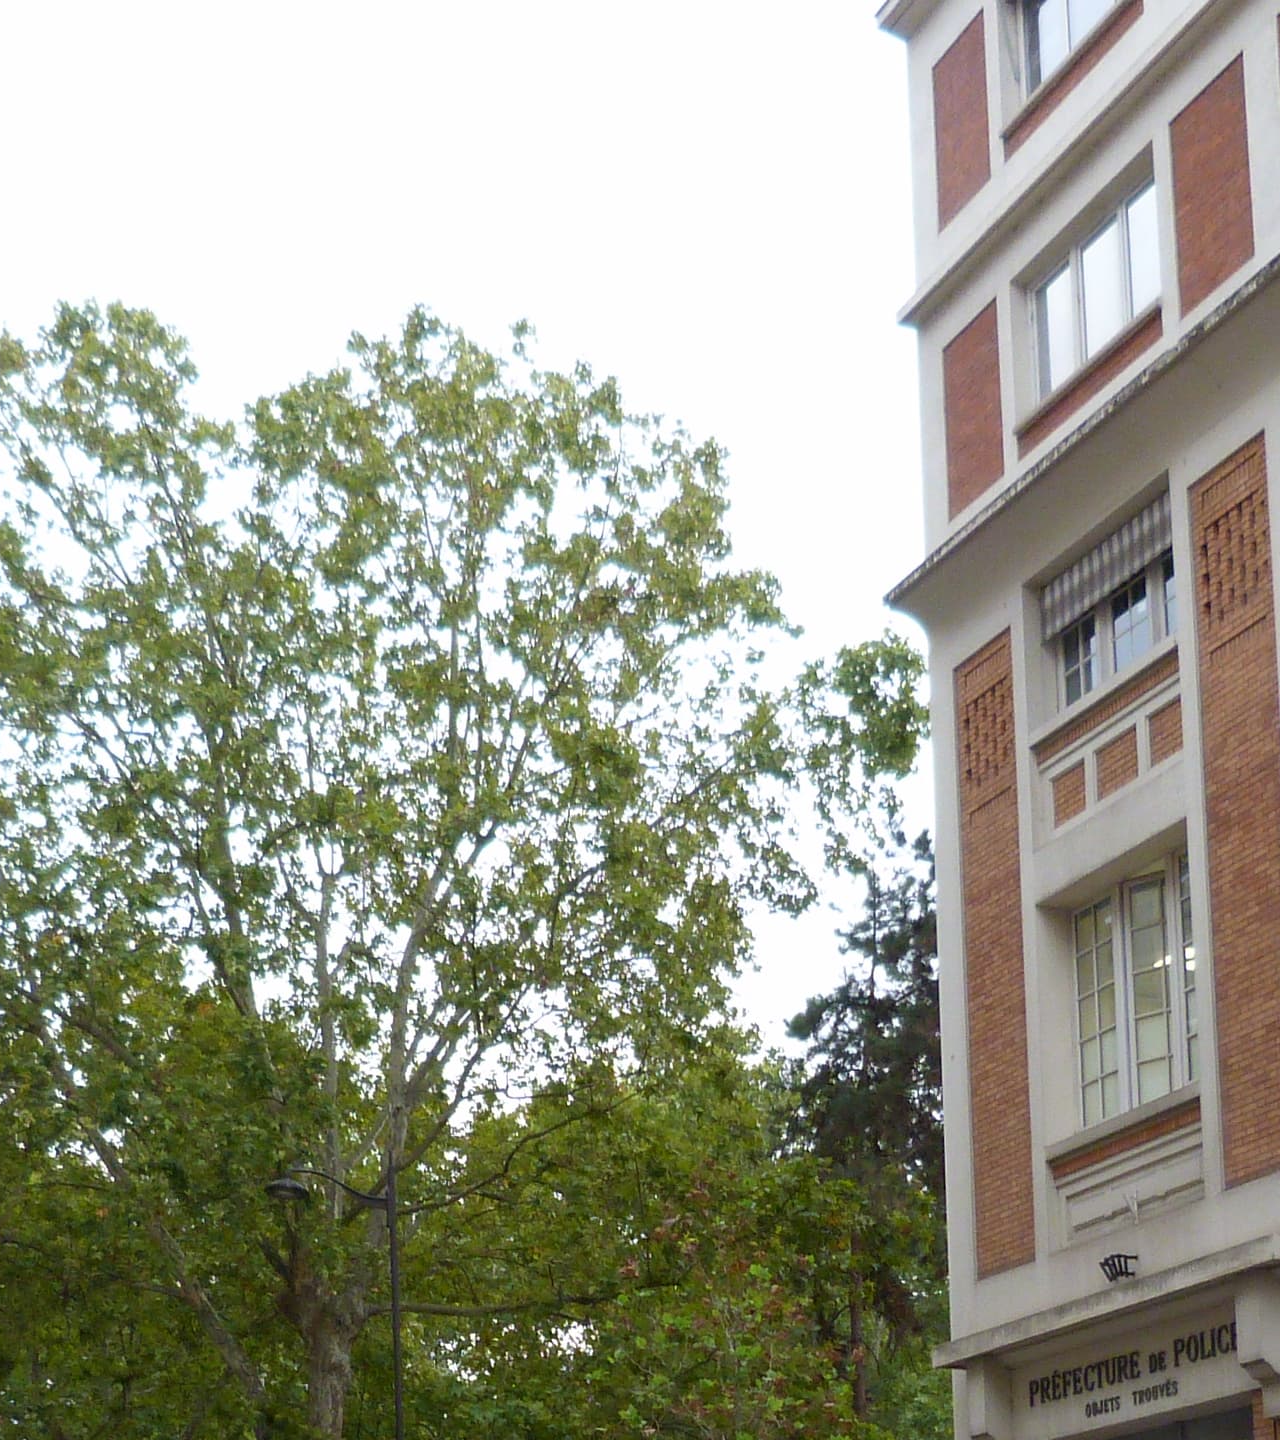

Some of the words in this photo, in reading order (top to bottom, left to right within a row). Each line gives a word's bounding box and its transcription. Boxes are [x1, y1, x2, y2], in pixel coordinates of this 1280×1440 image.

[1029, 1350, 1141, 1408] PRÉFECTURE
[1085, 1396, 1120, 1418] OBJETS
[1132, 1379, 1178, 1406] TROUVÉS
